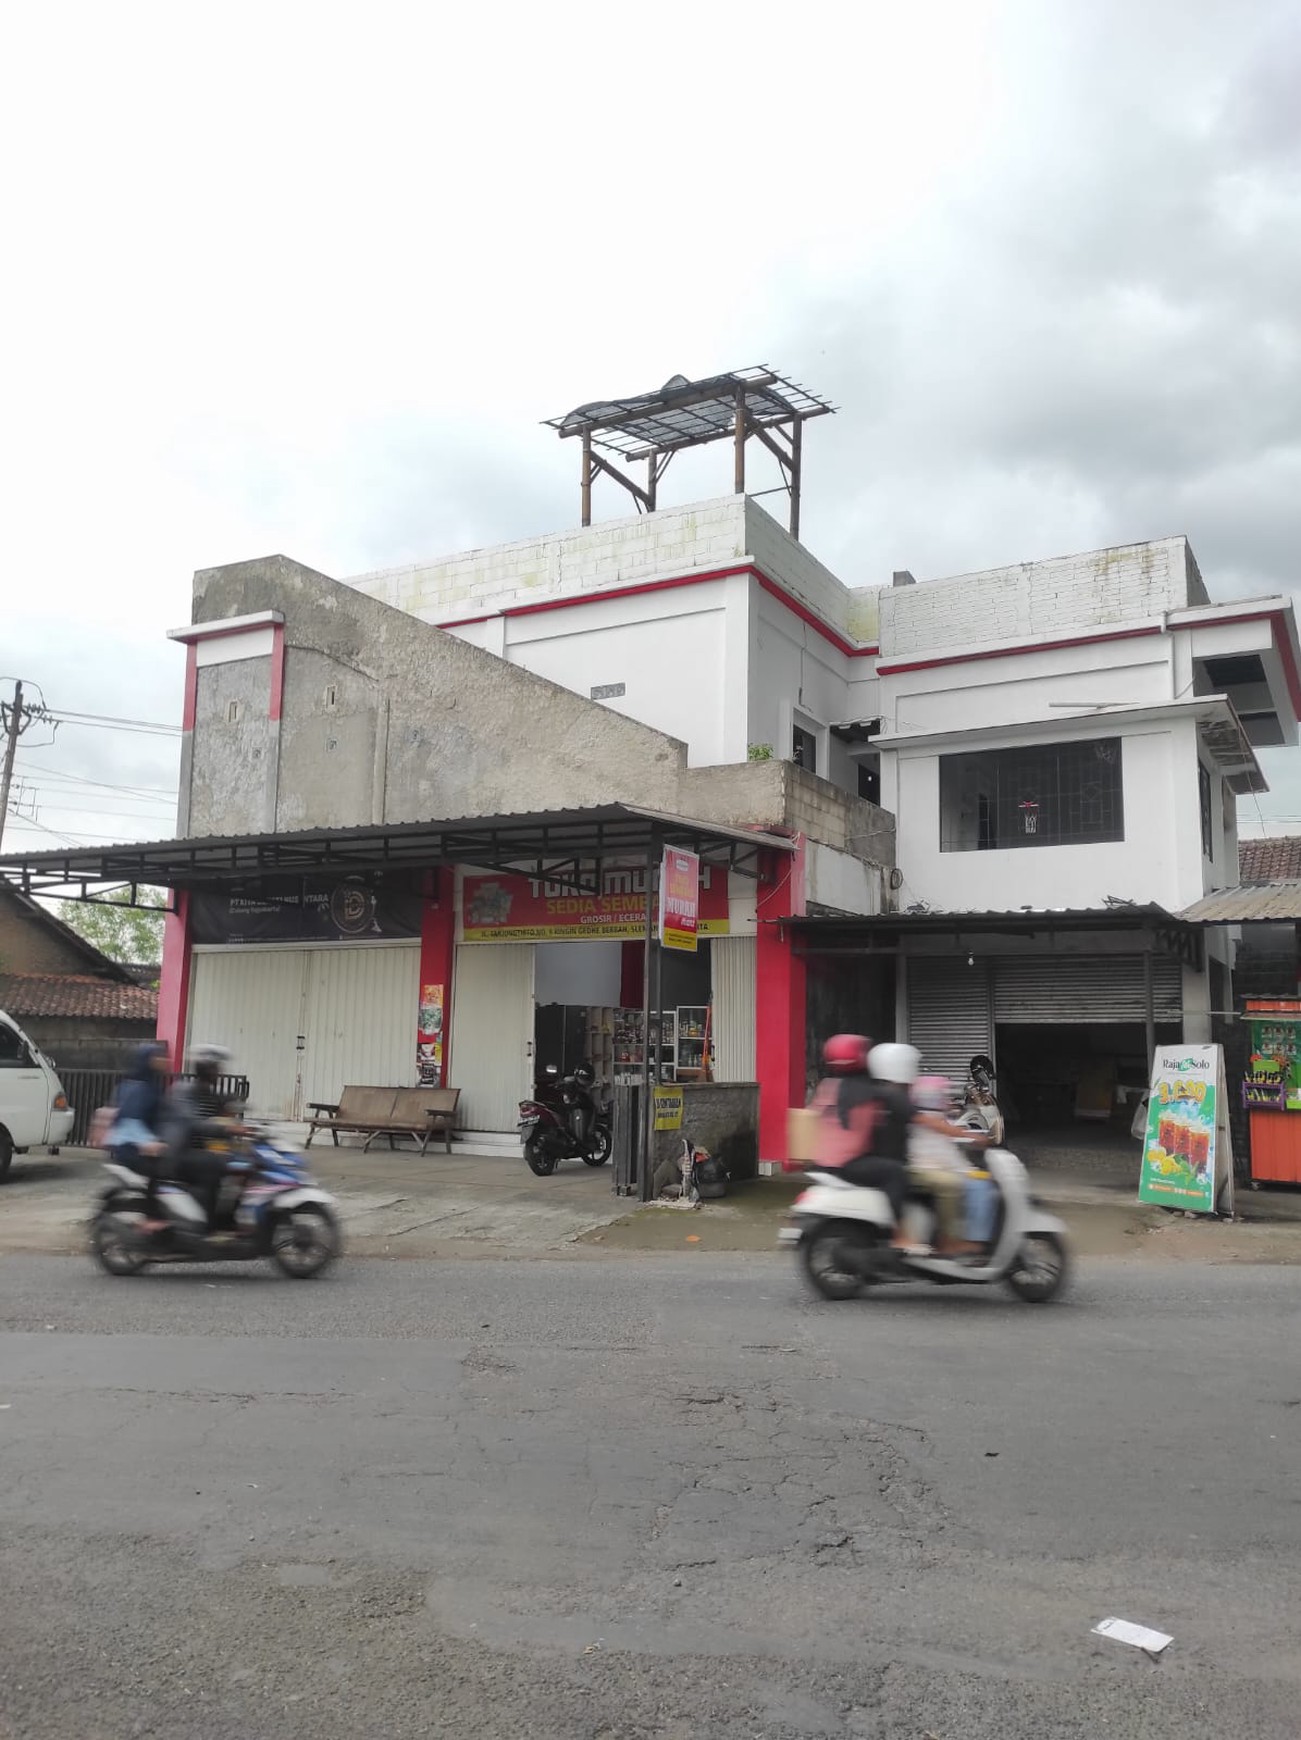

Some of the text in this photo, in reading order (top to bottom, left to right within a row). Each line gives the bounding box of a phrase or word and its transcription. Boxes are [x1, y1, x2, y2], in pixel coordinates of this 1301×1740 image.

[603, 867, 711, 893] MUH
[546, 895, 659, 914] SEDIA SEMBA
[580, 915, 612, 924] GROSIR
[619, 912, 647, 922] ECERA
[1163, 1059, 1179, 1071] Raja
[1192, 1059, 1210, 1069] Solo
